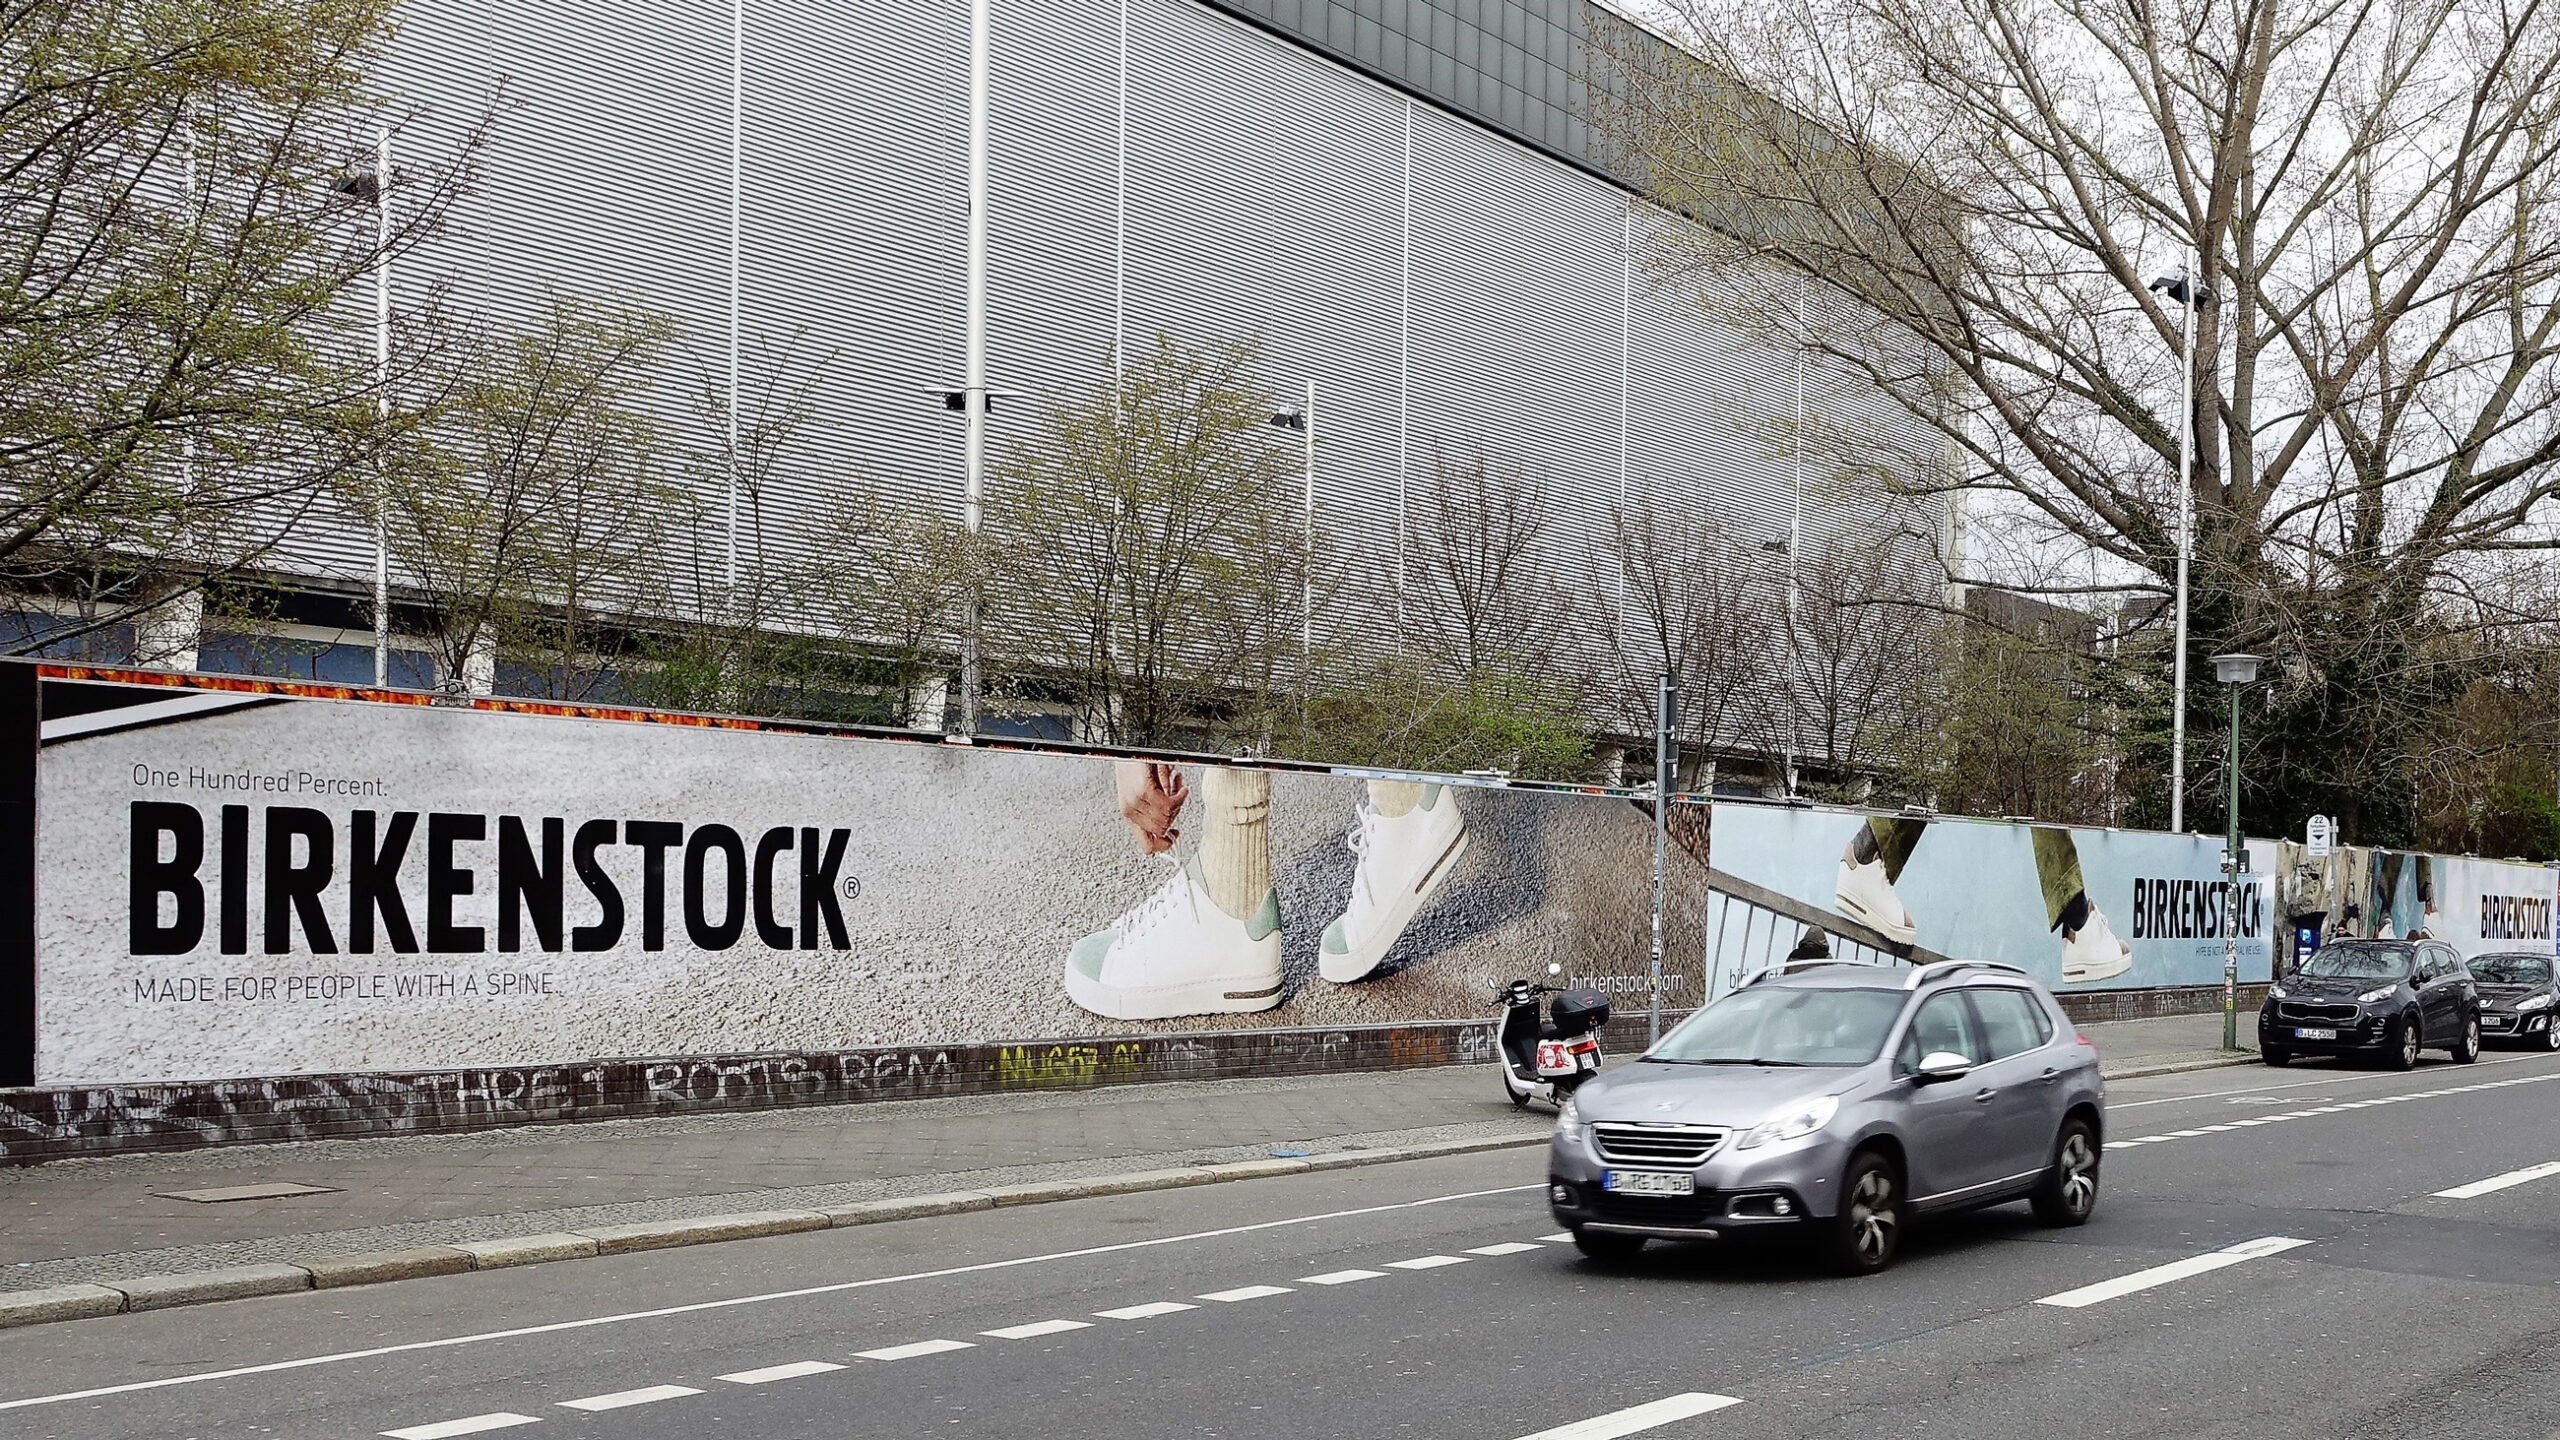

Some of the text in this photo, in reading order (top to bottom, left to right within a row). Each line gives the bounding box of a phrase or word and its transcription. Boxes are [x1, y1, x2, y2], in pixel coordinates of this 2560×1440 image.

[133, 763, 388, 797] One Hundred Percent.
[2314, 816, 2324, 824] 22
[2480, 894, 2551, 940] BIRKENSTOCK
[134, 972, 560, 1002] MADE FOR PEOPLE WITH A SPINE.
